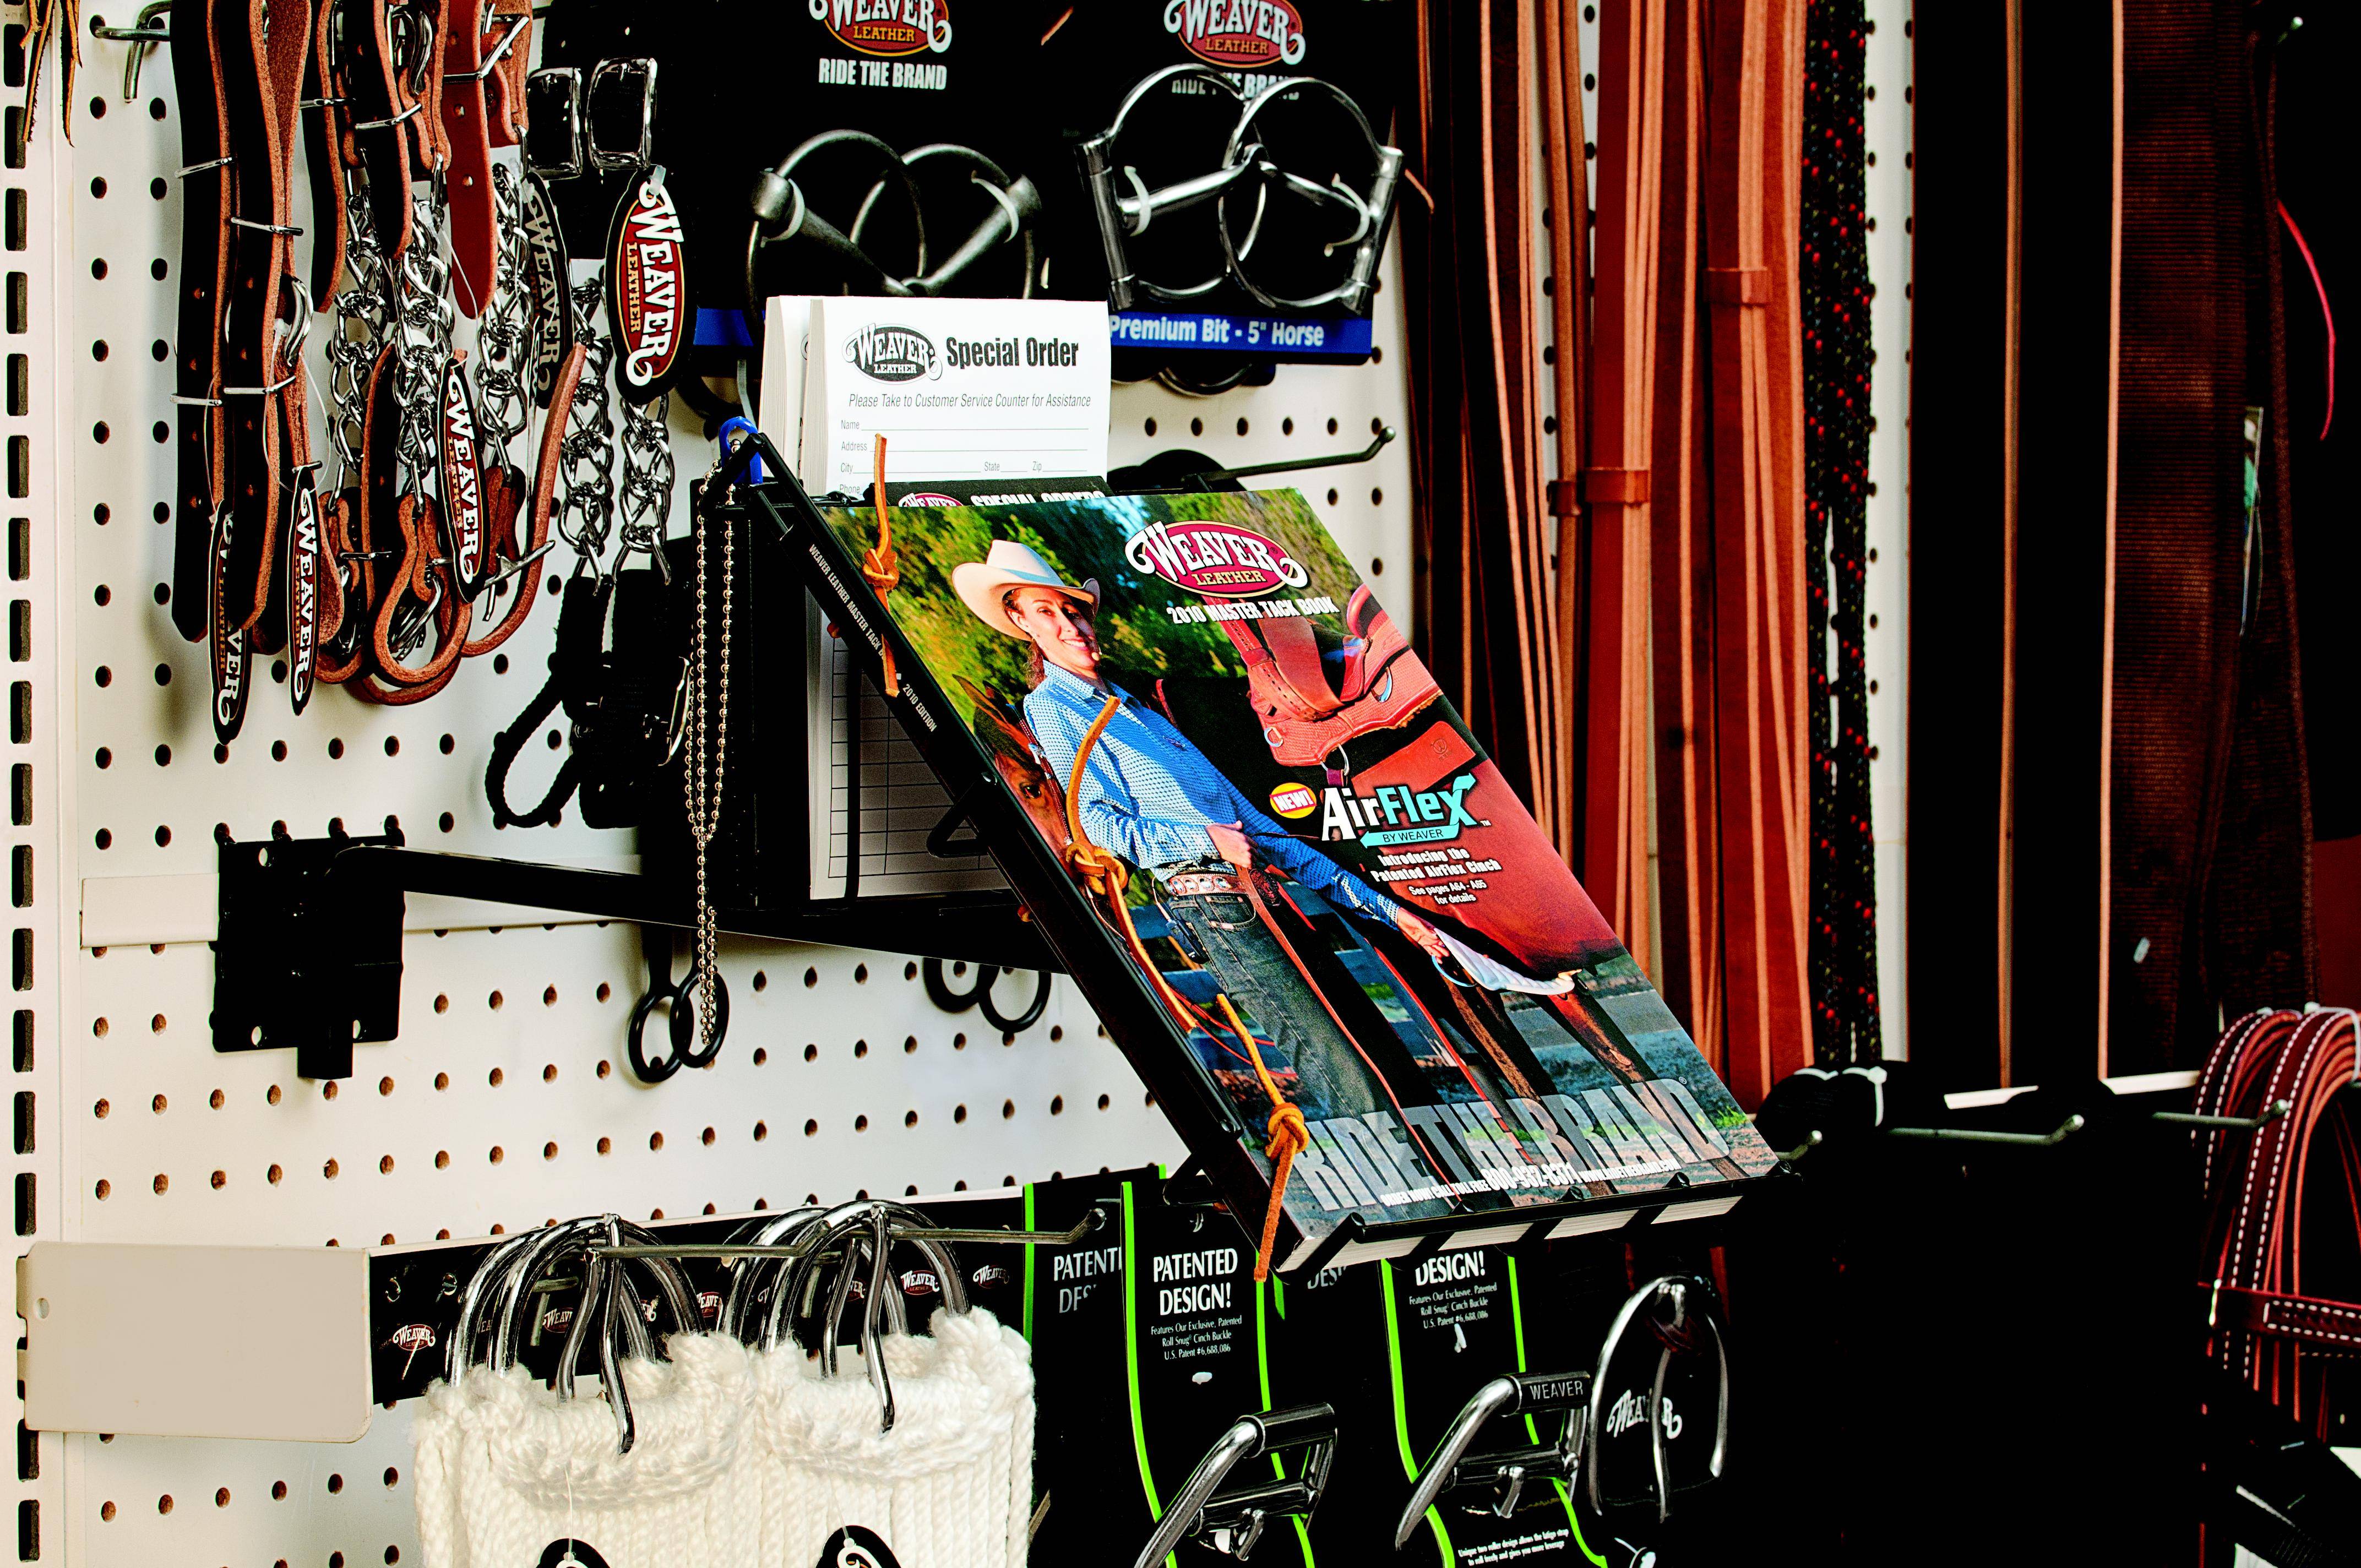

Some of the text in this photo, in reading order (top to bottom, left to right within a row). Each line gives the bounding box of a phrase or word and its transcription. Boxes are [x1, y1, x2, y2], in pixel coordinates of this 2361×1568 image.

[808, 0, 953, 53] WEAVER
[853, 25, 915, 42] LEATHER
[1163, 0, 1305, 65] WEAVER
[1205, 38, 1269, 54] LEATHER
[819, 58, 947, 90] RIDE THE BRAND
[626, 178, 684, 386] WEAVER
[627, 242, 640, 333] LEATHER
[1108, 315, 1196, 342] Premium
[1201, 318, 1231, 344] Bit
[1271, 321, 1325, 347] Horse
[843, 323, 943, 381] WEAVER
[946, 337, 1079, 369] Special Order
[874, 363, 917, 374] LEATHER
[849, 393, 1091, 407] Please Take to Customer Service Counter for Assistance
[841, 420, 859, 430] Name
[841, 442, 868, 451] Address
[840, 461, 1042, 473] City State Zip
[447, 374, 478, 584] WEAVER
[840, 484, 861, 495] Phone
[1125, 520, 1308, 588] WEAVER
[1190, 570, 1267, 586] LEATHER
[296, 488, 317, 701] WEAVER
[808, 543, 882, 651] WEAVER LEATHER MASTER TACK
[1166, 596, 1340, 624] 2010 MASTER TACK BOOK
[902, 683, 937, 732] 2010 EDITION
[1273, 790, 1314, 812] NEW!
[1322, 773, 1477, 841] AirFlex
[1383, 829, 1444, 843] BY WEAVER
[1378, 847, 1470, 867] Introducing the
[1370, 859, 1503, 882] Patented AirFlex Cinch
[1408, 886, 1426, 896] See
[1425, 884, 1450, 896] pages
[1449, 881, 1467, 891] A64
[1469, 879, 1487, 889] A65
[1434, 892, 1477, 905] for details
[1293, 1078, 1731, 1211] RIDE THE BRAND
[1431, 1184, 1455, 1199] CALL
[1450, 1181, 1474, 1195] TOLL
[1480, 1162, 1583, 1191] 800-932-8371
[1153, 1248, 1238, 1283] PATENTED
[1415, 1250, 1486, 1286] DESIGN!
[900, 1270, 940, 1292] WEAVER
[1432, 1292, 1444, 1302] Our
[1474, 1282, 1498, 1294] Patented
[1159, 1282, 1232, 1316] DESIGN!
[1421, 1305, 1432, 1316] Roll
[1451, 1299, 1468, 1311] Cinch
[1469, 1296, 1489, 1309] Buckle
[1151, 1315, 1242, 1336] Features Our Exclusive, Patented
[1423, 1318, 1436, 1329] U.S.
[392, 1325, 436, 1347] WEAVER
[1162, 1336, 1174, 1347] Roll
[1193, 1332, 1211, 1343] Cinch
[1212, 1329, 1232, 1341] Buckle
[1164, 1350, 1177, 1360] U.S.
[1178, 1348, 1195, 1358] Patent
[1529, 1380, 1584, 1401] WEAVER
